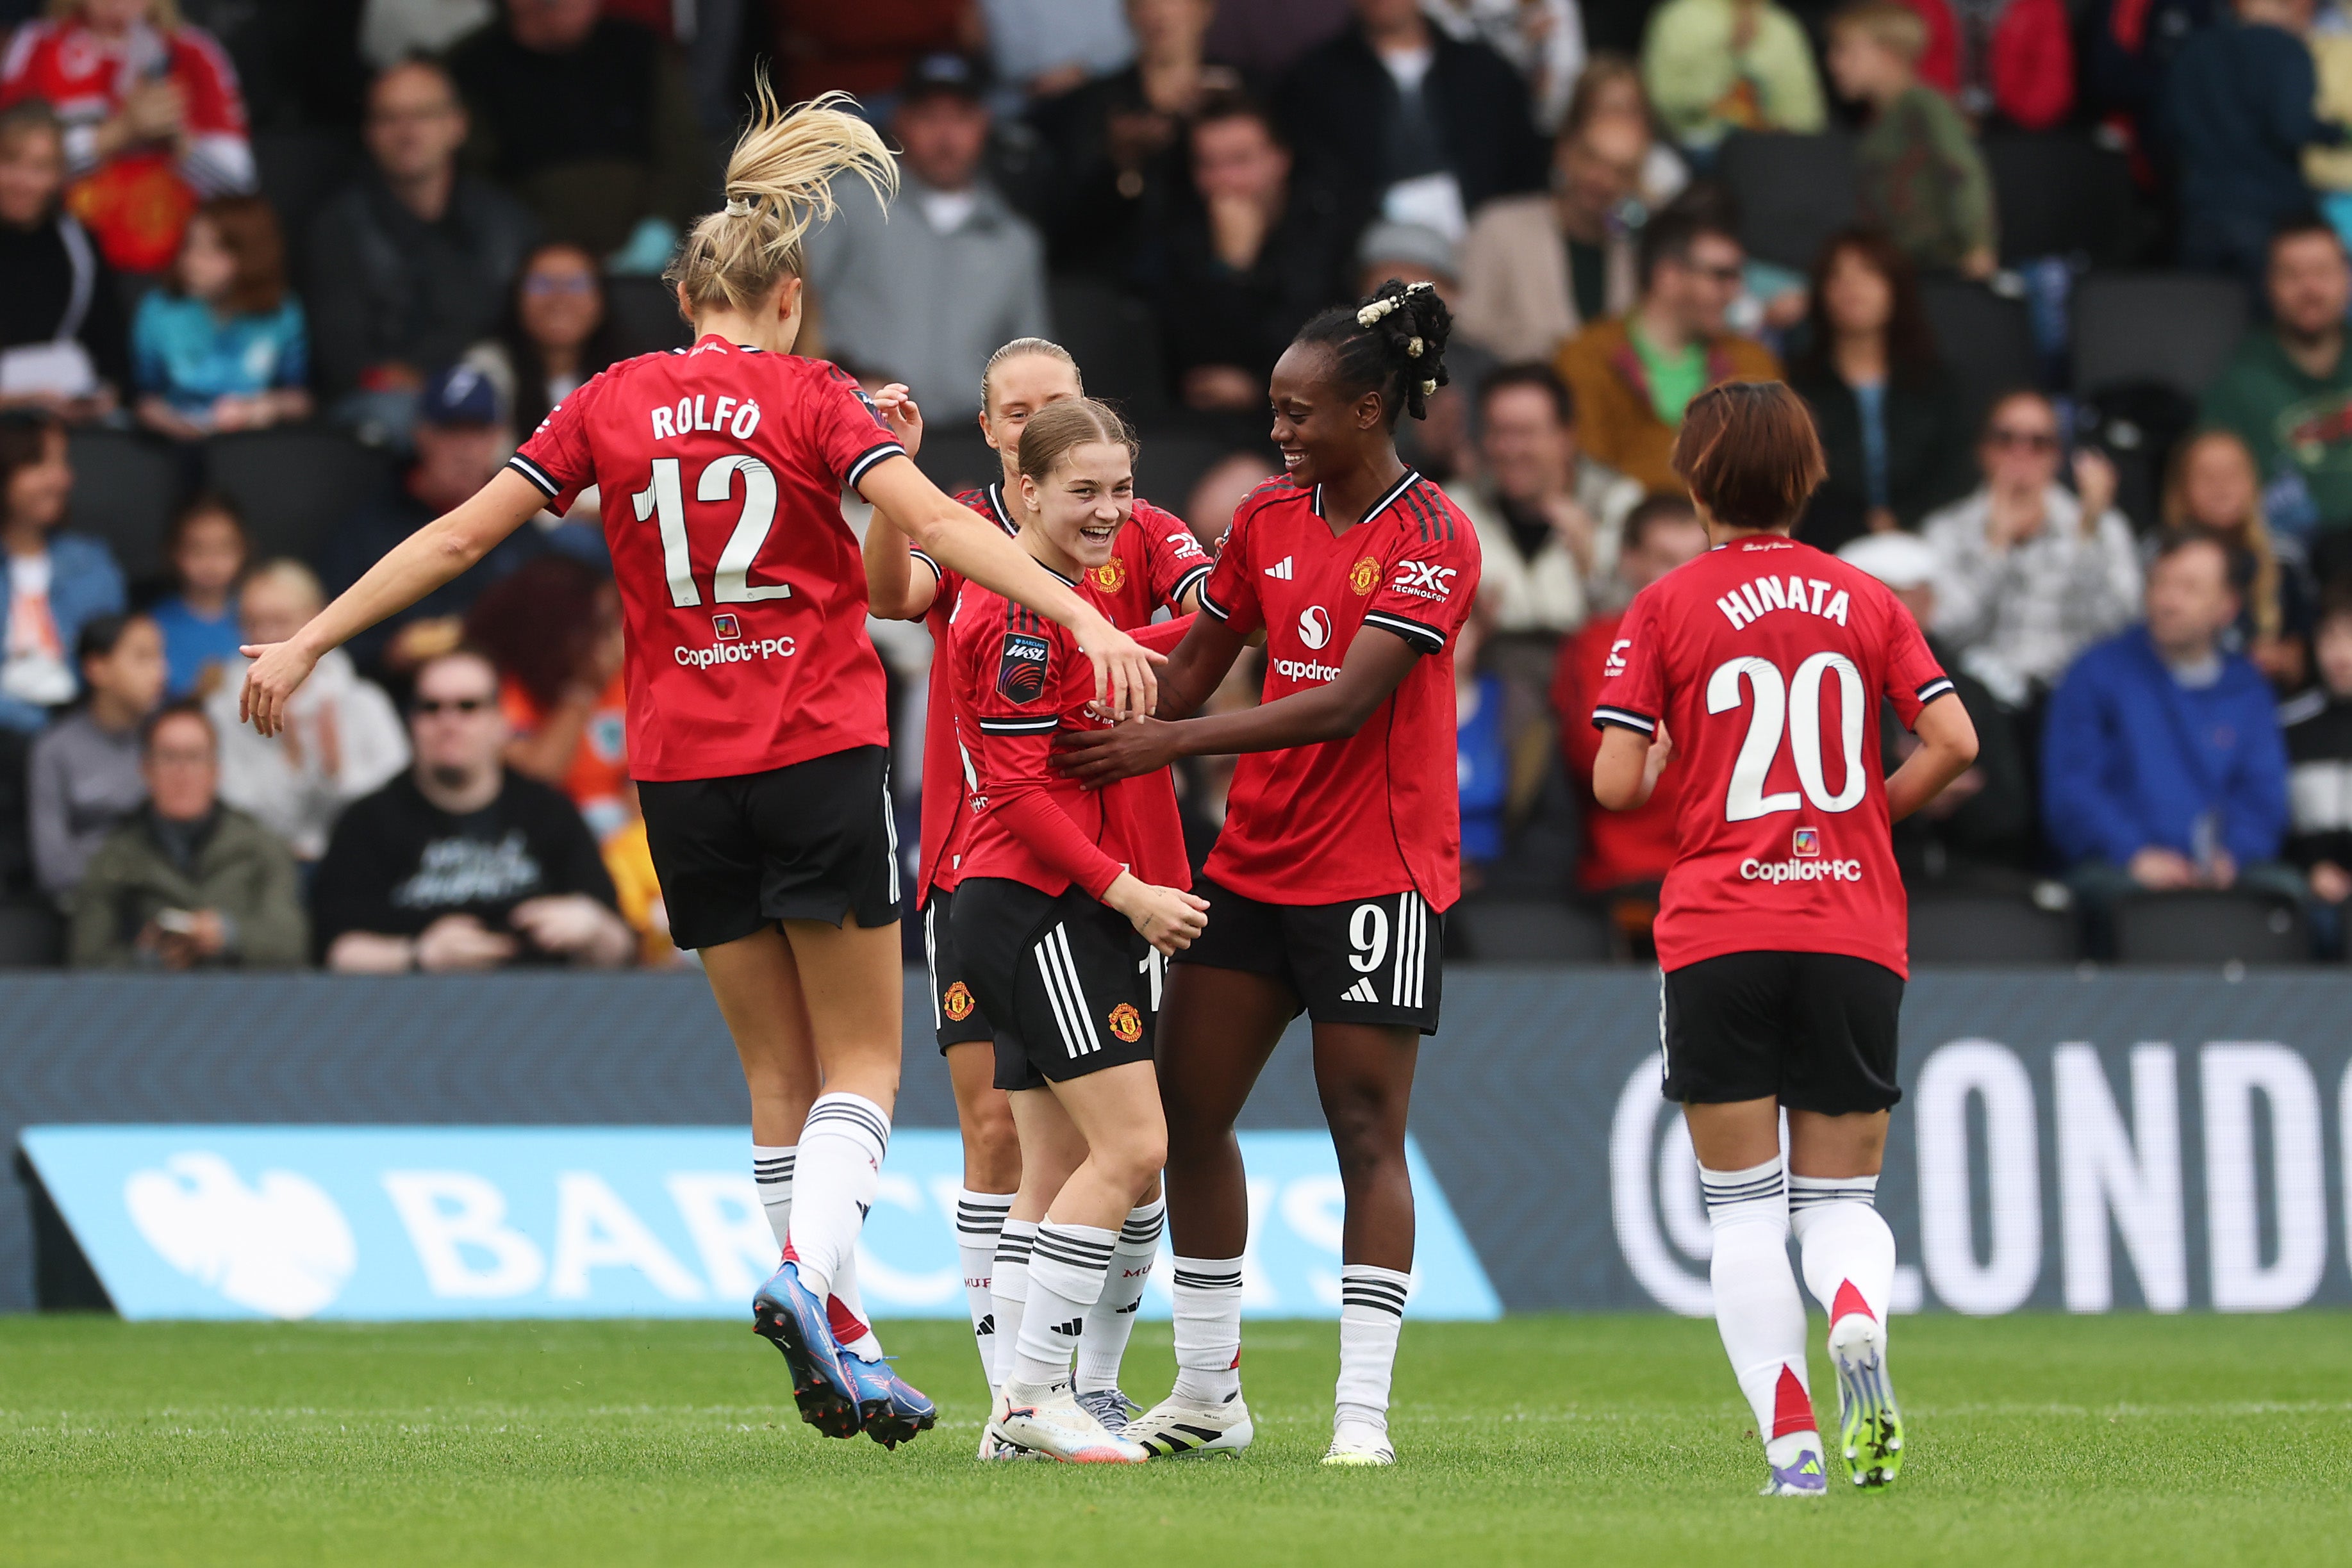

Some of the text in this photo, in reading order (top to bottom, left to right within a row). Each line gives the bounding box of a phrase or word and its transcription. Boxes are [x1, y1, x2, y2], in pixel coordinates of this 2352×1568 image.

[650, 393, 761, 440] ROLFÖ
[631, 454, 793, 607] 12
[1392, 584, 1447, 604] TECHNOLOGY
[1395, 560, 1457, 595] DXC
[1716, 575, 1850, 631] HINATA
[1005, 644, 1045, 661] WSL
[1021, 640, 1045, 649] BARCLAYS
[1705, 651, 1866, 823] 20
[1348, 904, 1389, 973] 9
[1139, 944, 1169, 1012] 1
[964, 1277, 991, 1289] MUF
